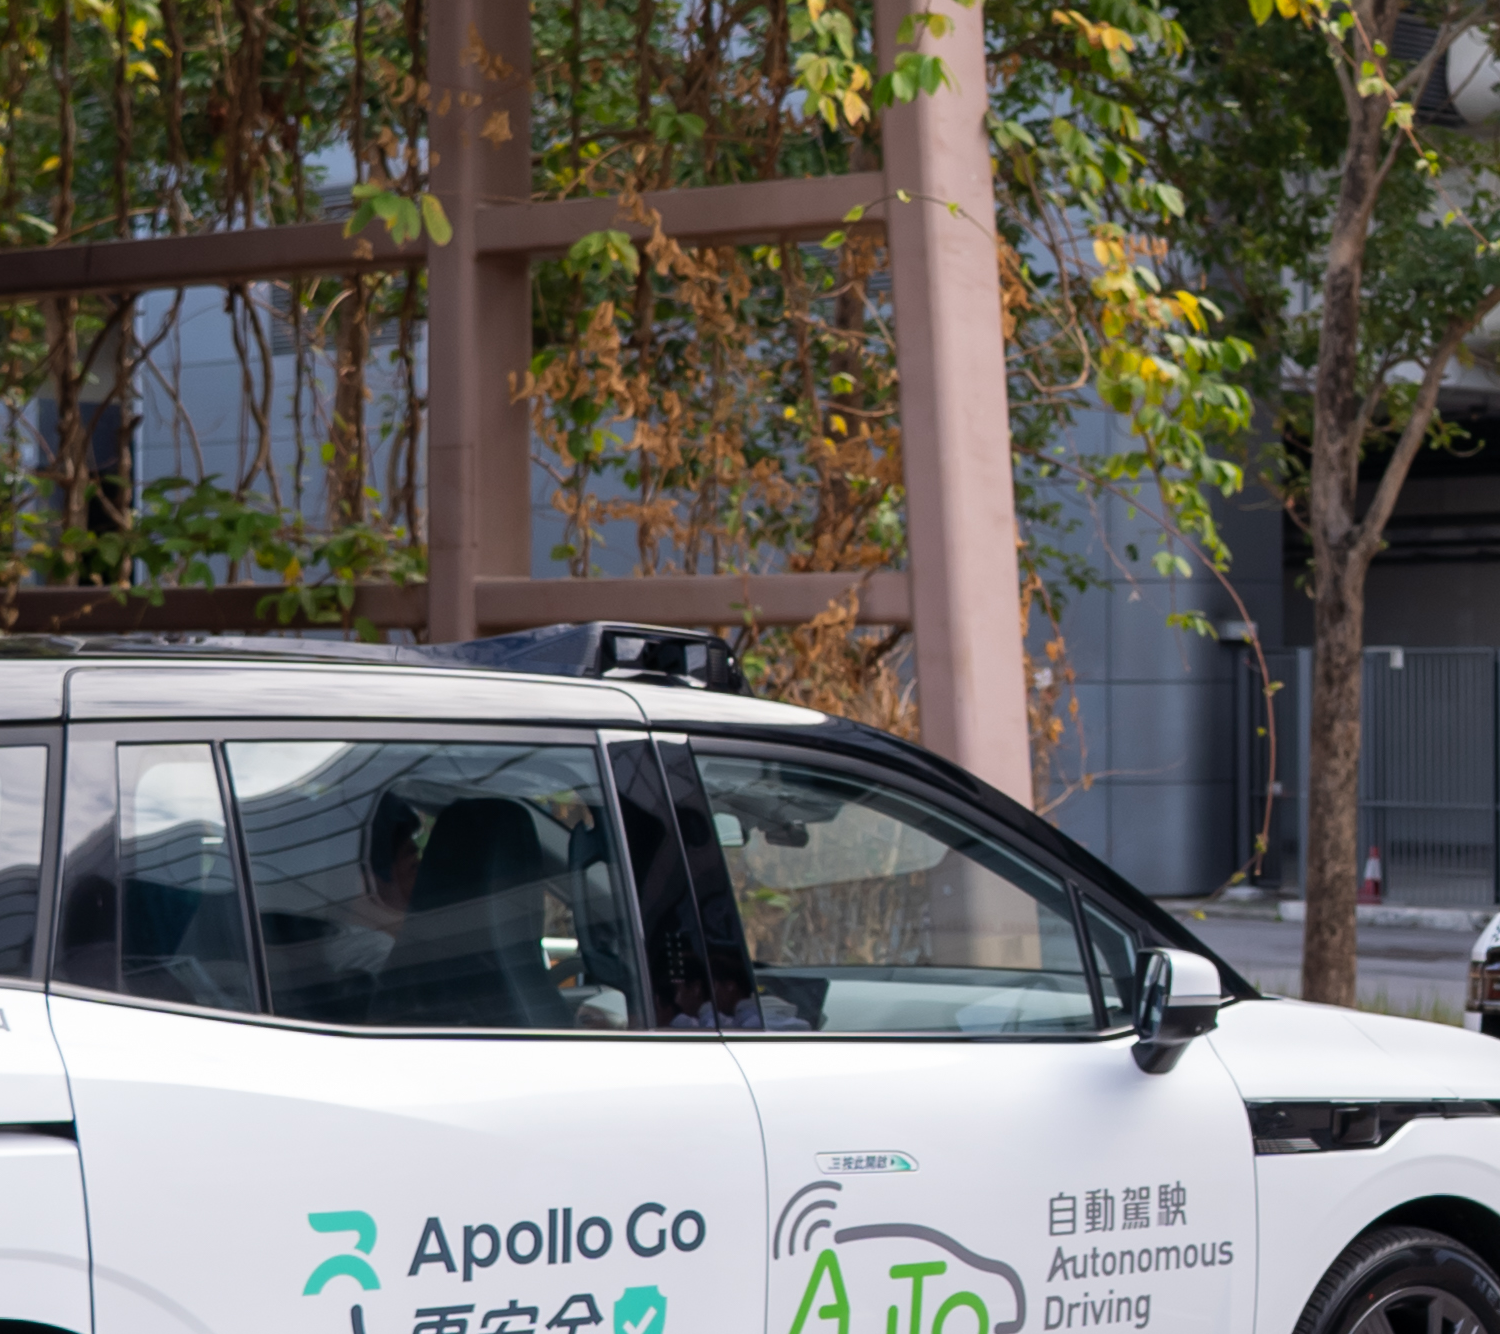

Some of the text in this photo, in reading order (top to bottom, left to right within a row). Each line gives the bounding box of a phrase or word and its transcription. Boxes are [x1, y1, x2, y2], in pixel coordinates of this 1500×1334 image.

[1046, 1179, 1190, 1239] 自動駕駛
[406, 1200, 707, 1283] Apollo Go
[1046, 1239, 1236, 1284] Autonomous
[1043, 1288, 1152, 1333] Driving
